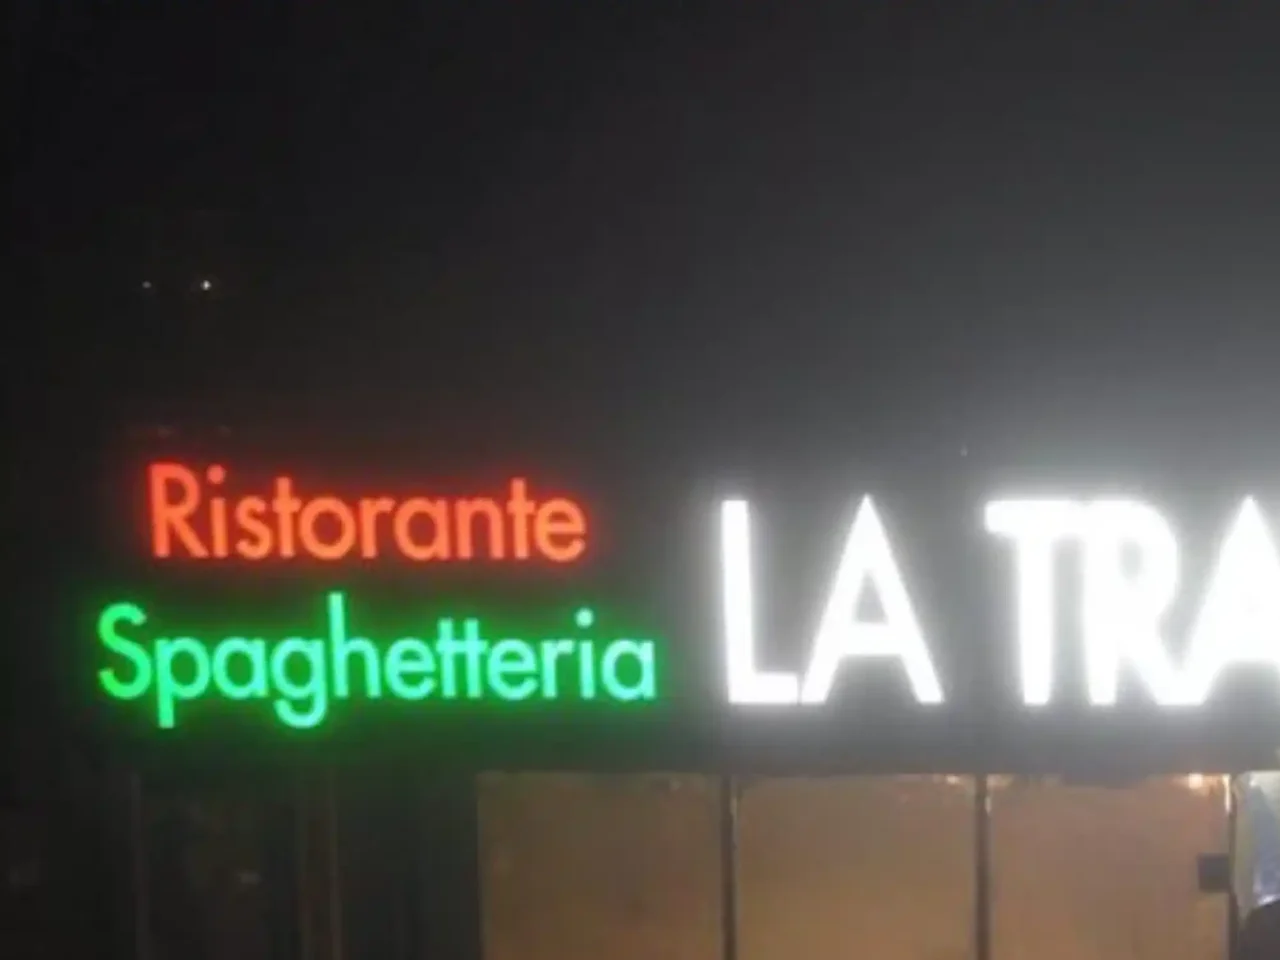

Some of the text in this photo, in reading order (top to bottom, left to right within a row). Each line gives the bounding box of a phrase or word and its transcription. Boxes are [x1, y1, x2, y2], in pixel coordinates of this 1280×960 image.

[149, 463, 588, 561] Ristorante
[99, 592, 657, 728] Spaghetteria
[718, 496, 944, 705] LA
